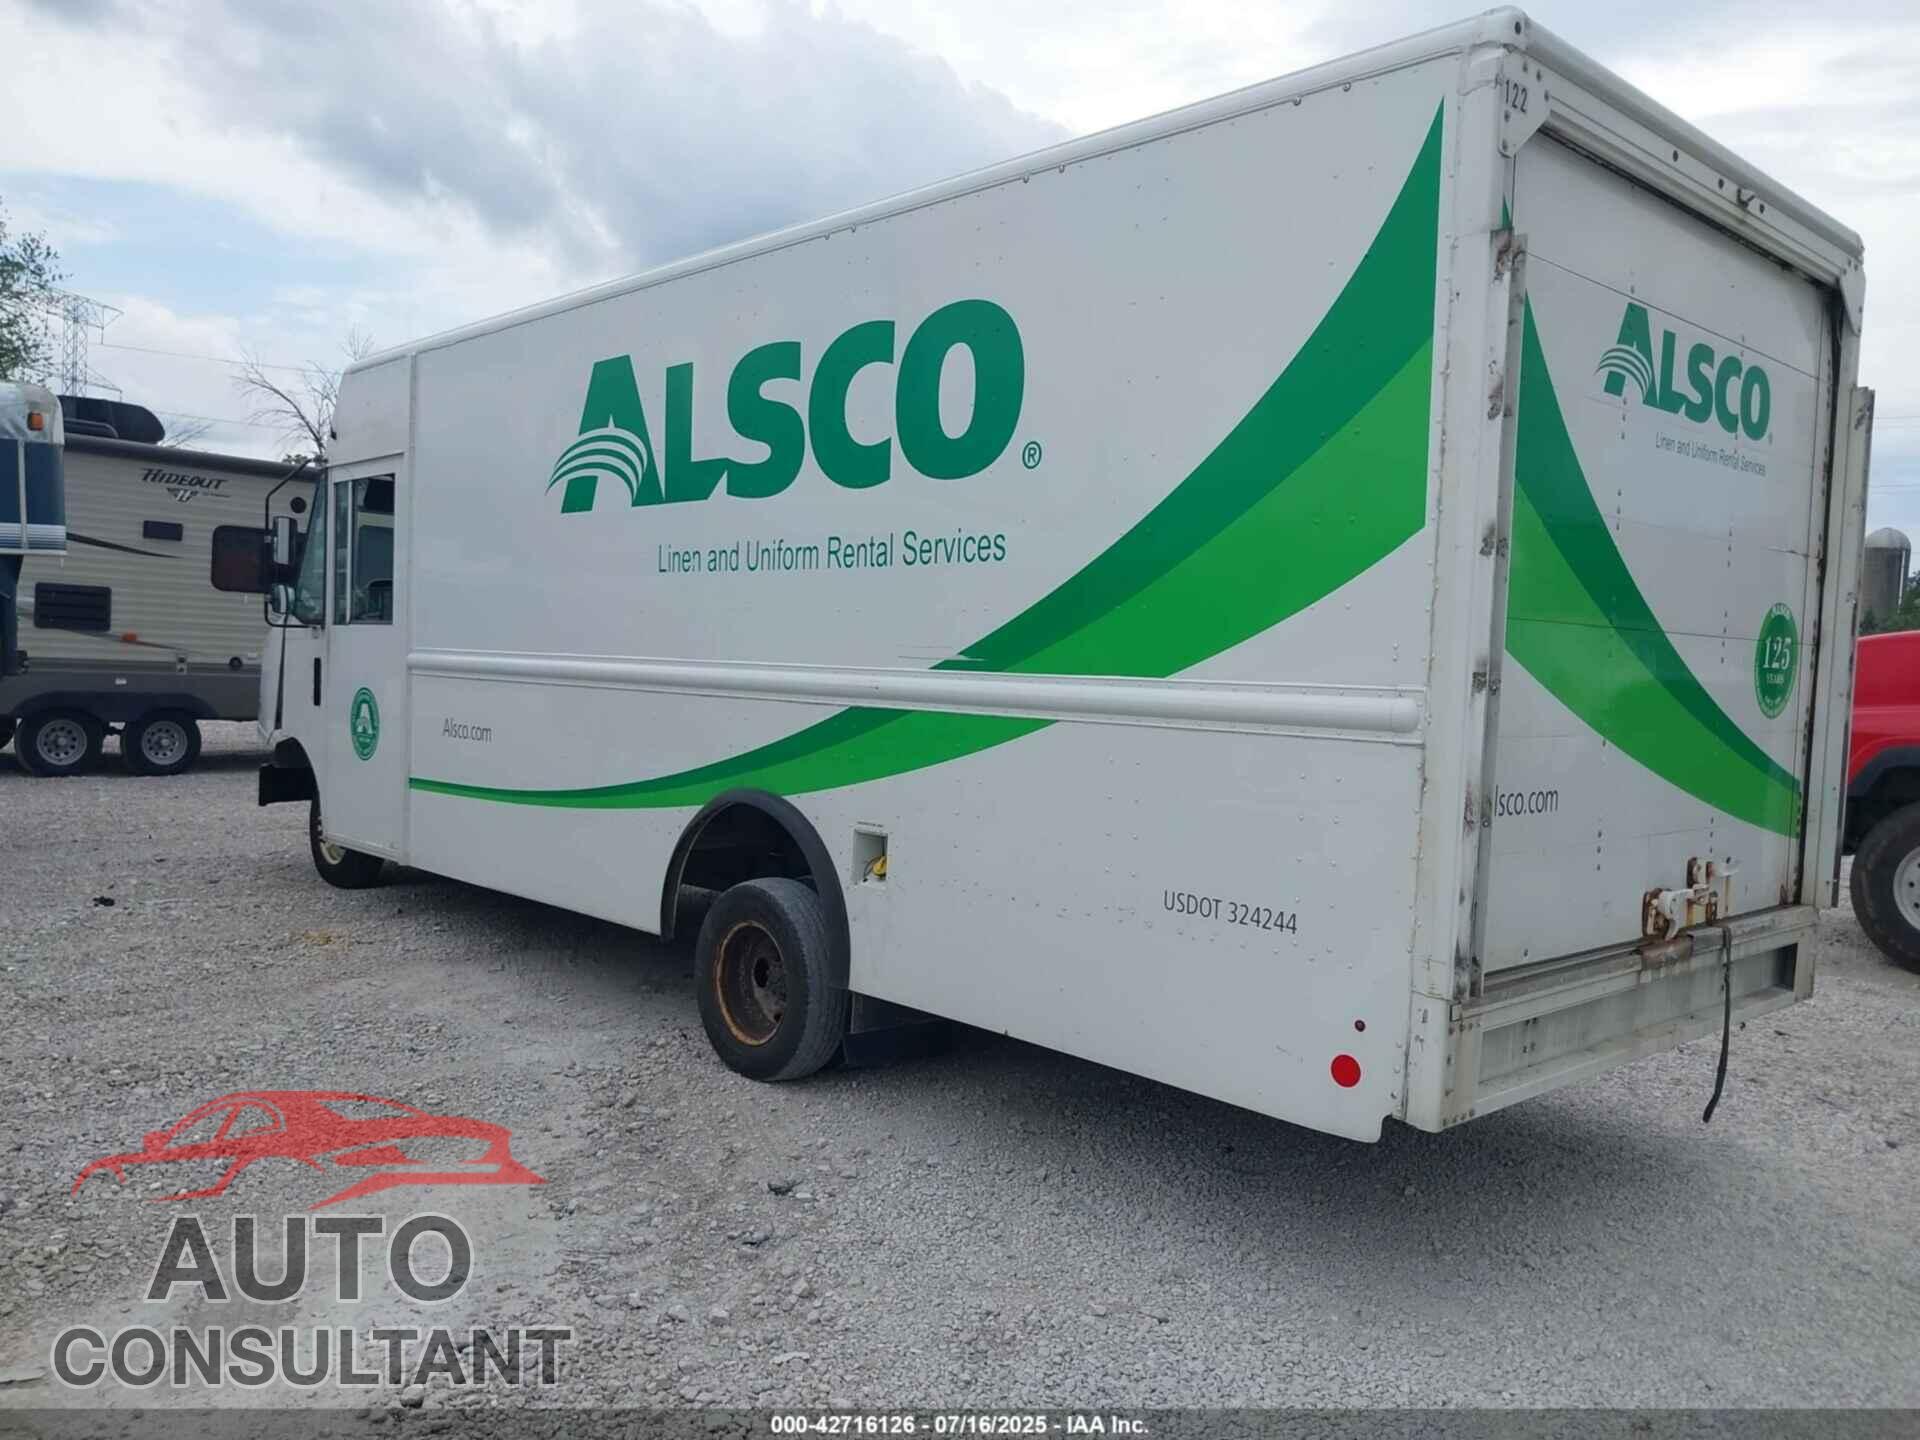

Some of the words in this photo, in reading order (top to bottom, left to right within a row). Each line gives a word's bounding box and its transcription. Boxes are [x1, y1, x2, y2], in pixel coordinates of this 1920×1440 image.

[1504, 79, 1528, 113] 122
[1595, 302, 1771, 441] ALSCO
[545, 299, 1025, 514] ALSCO
[658, 544, 701, 572] Linen
[708, 541, 740, 572] and
[747, 539, 819, 571] Uniform
[827, 532, 894, 568] Rental
[902, 527, 1006, 566] Services
[1763, 637, 1792, 669] 125
[442, 717, 492, 742] Alsco.com
[1494, 784, 1559, 816] lsco.com
[1164, 890, 1223, 920] USDOT
[1227, 901, 1297, 935] 324244
